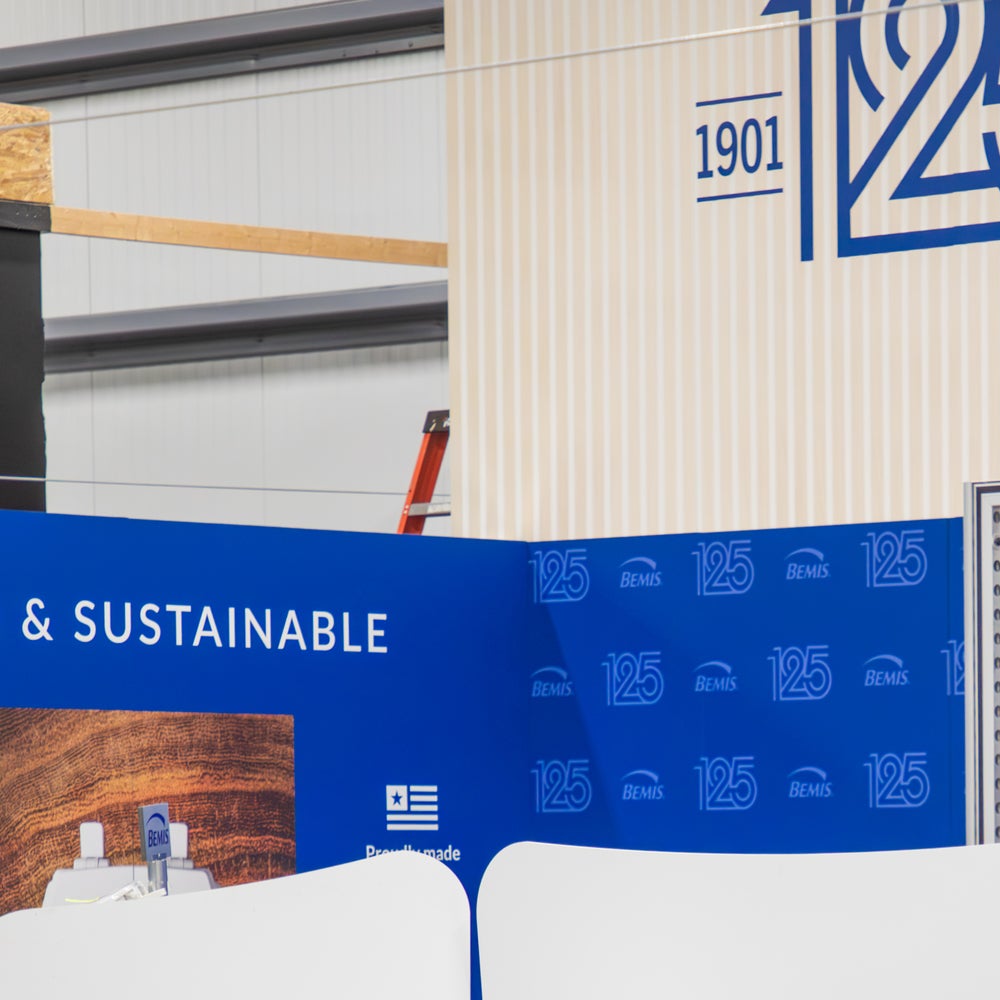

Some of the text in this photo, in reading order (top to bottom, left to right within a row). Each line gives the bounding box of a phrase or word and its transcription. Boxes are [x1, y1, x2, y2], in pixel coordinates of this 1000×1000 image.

[696, 115, 784, 180] 1901
[528, 548, 590, 603] 125
[620, 571, 661, 588] BEMIS
[691, 539, 755, 597] 125
[786, 562, 829, 580] BEMIS
[860, 529, 928, 588] 125
[21, 597, 389, 654] & SUSTAINABLE
[531, 679, 573, 697] BEMIS
[602, 651, 664, 706] 125
[694, 675, 737, 692] BEMIS
[767, 645, 833, 702] 125
[865, 669, 909, 687] BEMIS
[531, 759, 592, 813] 125
[622, 783, 664, 800] BEMIS
[694, 756, 758, 811] 125
[789, 781, 832, 798] BEMIS
[863, 752, 930, 809] 125
